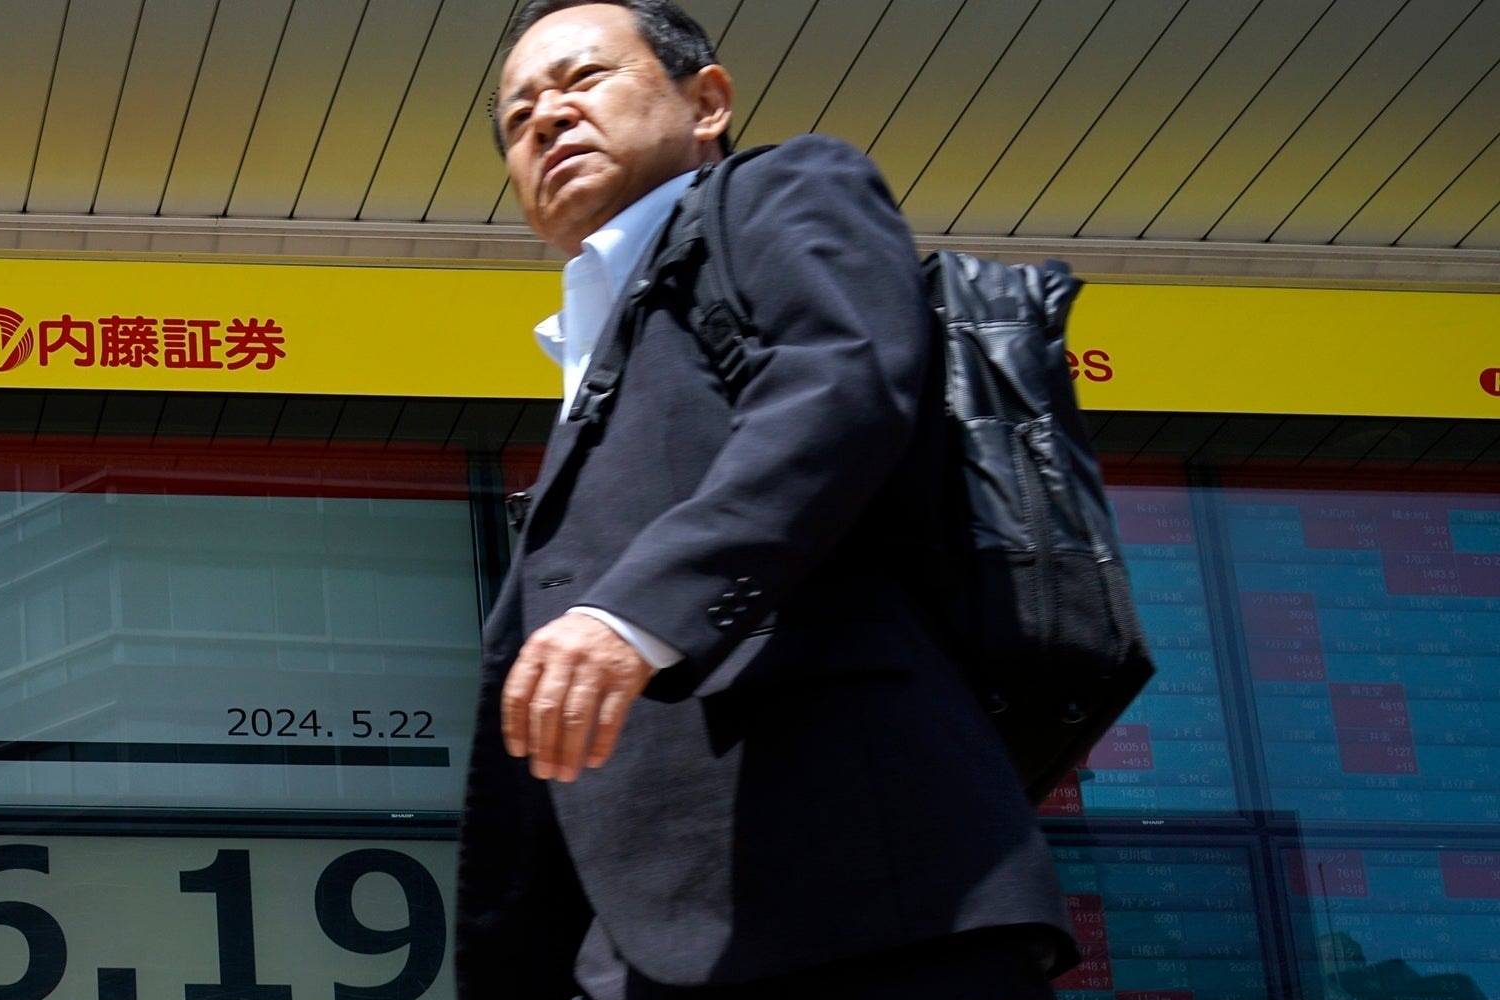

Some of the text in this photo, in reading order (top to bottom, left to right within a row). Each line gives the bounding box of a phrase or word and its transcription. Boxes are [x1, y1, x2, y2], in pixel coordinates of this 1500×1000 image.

[38, 314, 287, 371] 内藤証券
[1424, 526, 1448, 535] 3612
[1473, 556, 1500, 566] ZOZ
[1423, 569, 1455, 579] 1483.5
[227, 708, 435, 739] 2024. 5.22
[1113, 743, 1148, 752] 2005.0
[1387, 747, 1412, 757] 5127
[1123, 759, 1150, 767] +49.5
[1179, 774, 1211, 783] SMC
[1337, 869, 1362, 878] 7610
[1076, 913, 1101, 923] 4123
[1091, 929, 1103, 937] +9
[1081, 977, 1109, 987] +16.7
